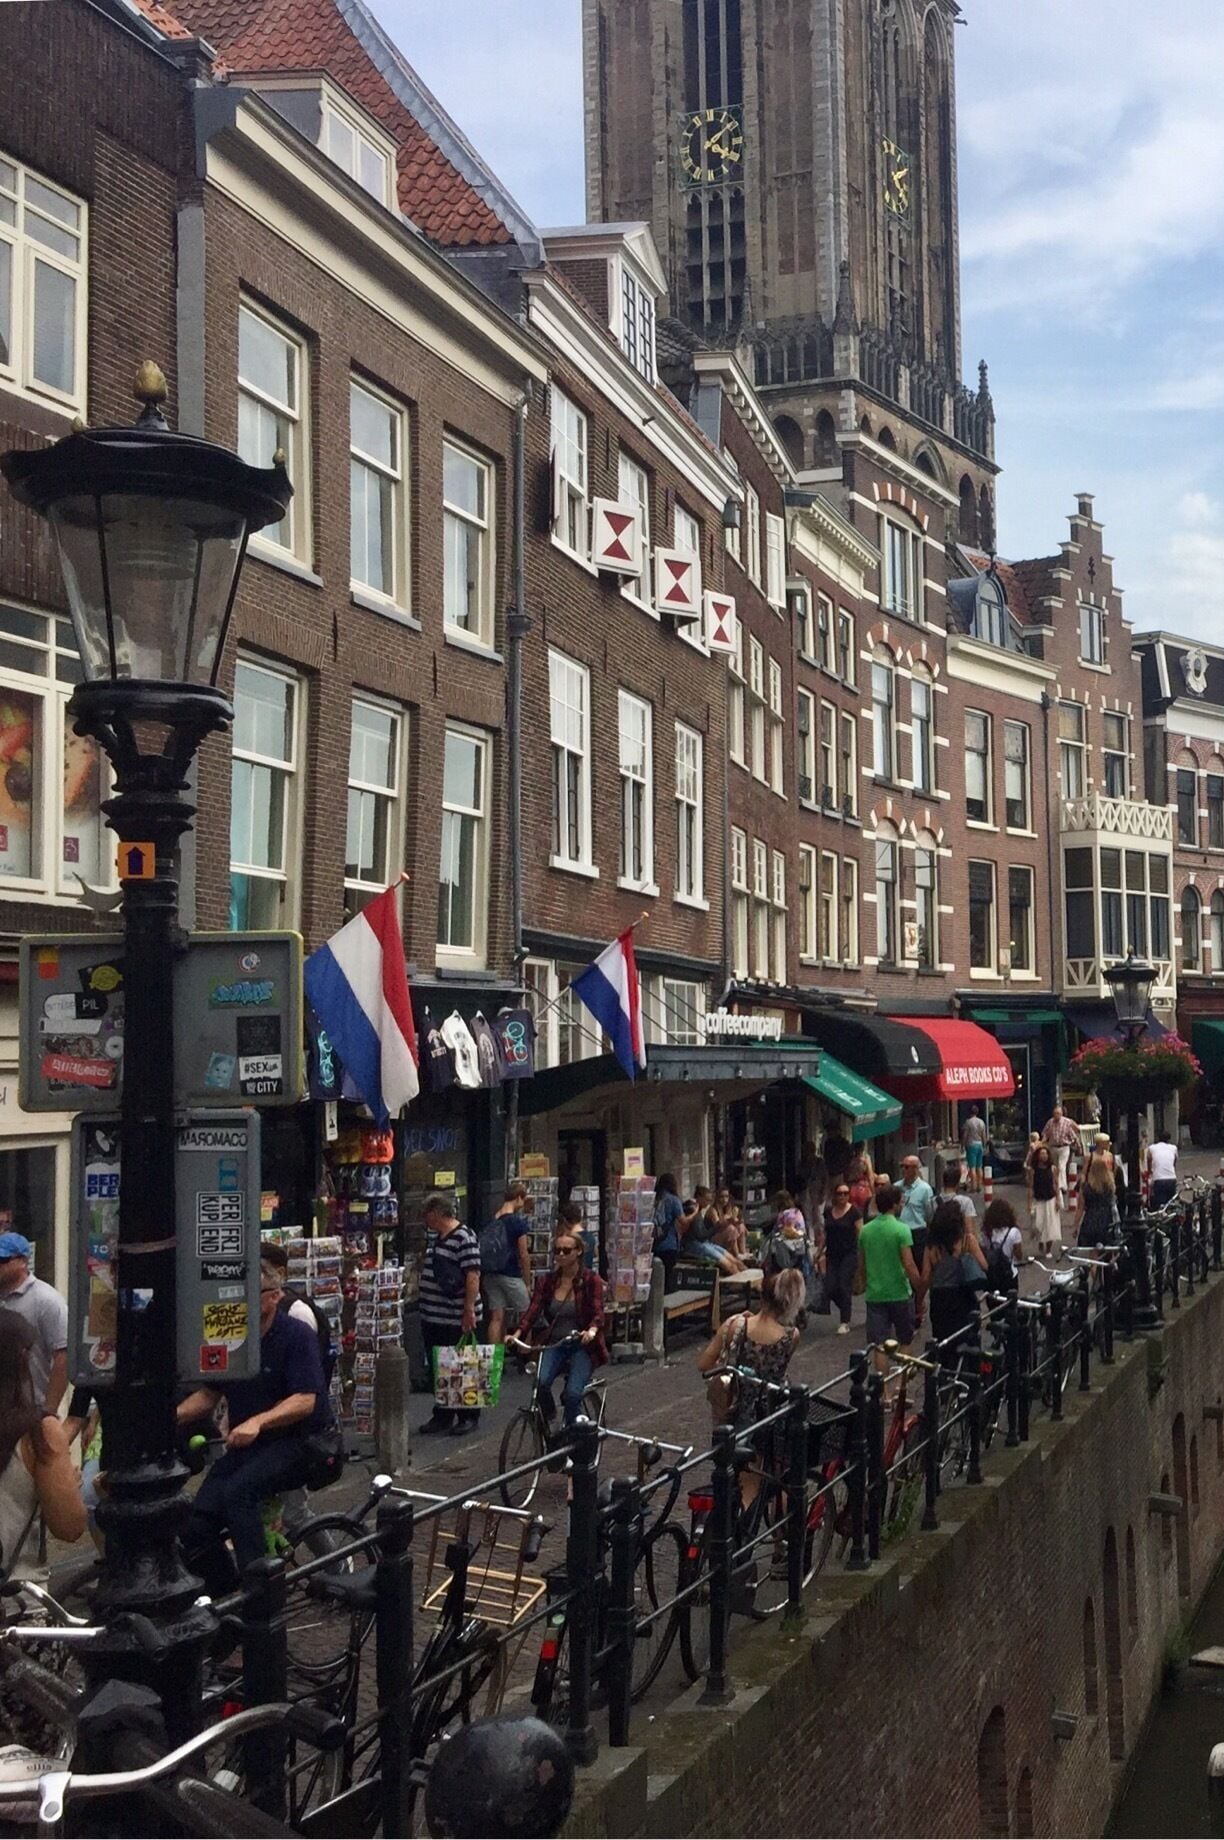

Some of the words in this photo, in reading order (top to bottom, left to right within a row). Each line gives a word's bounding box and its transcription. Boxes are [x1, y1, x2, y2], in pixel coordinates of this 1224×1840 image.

[82, 999, 100, 1011] PIL
[706, 1007, 782, 1042] coffeecompany
[244, 1062, 269, 1074] #SEX
[946, 1067, 969, 1085] ALEPH
[969, 1066, 993, 1084] BOOKS
[256, 1080, 279, 1094] CITY
[200, 1227, 220, 1253] END
